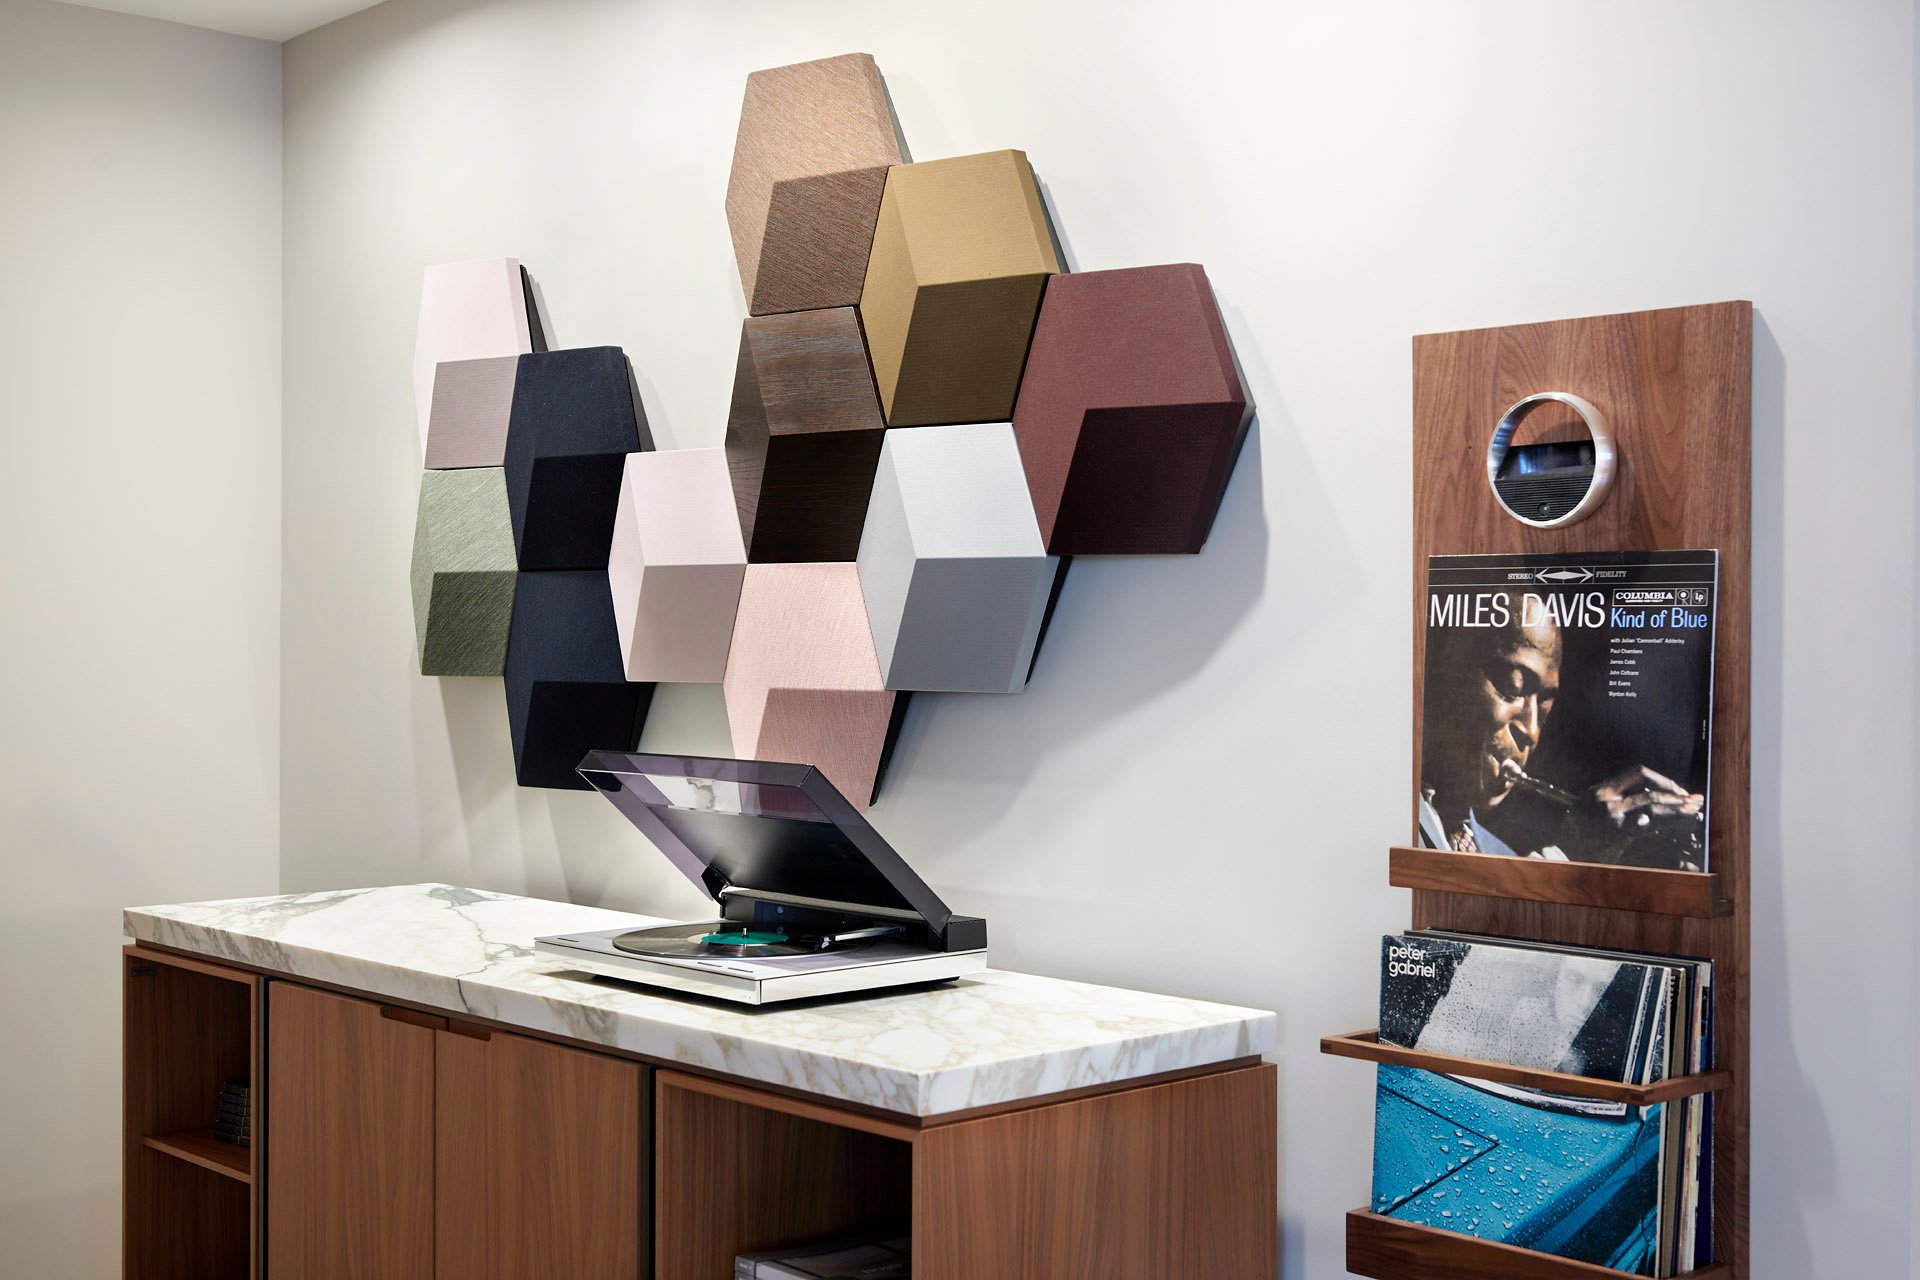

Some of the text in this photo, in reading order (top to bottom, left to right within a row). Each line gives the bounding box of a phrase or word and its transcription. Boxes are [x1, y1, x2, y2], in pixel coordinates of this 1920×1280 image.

[1595, 570, 1627, 578] FIDELITY
[1615, 591, 1674, 600] COLUMBIA
[1430, 591, 1606, 628] MILES DAVIS
[1610, 607, 1708, 628] Kind of Blue
[1389, 944, 1426, 961] peter
[1389, 959, 1435, 978] gabriel
